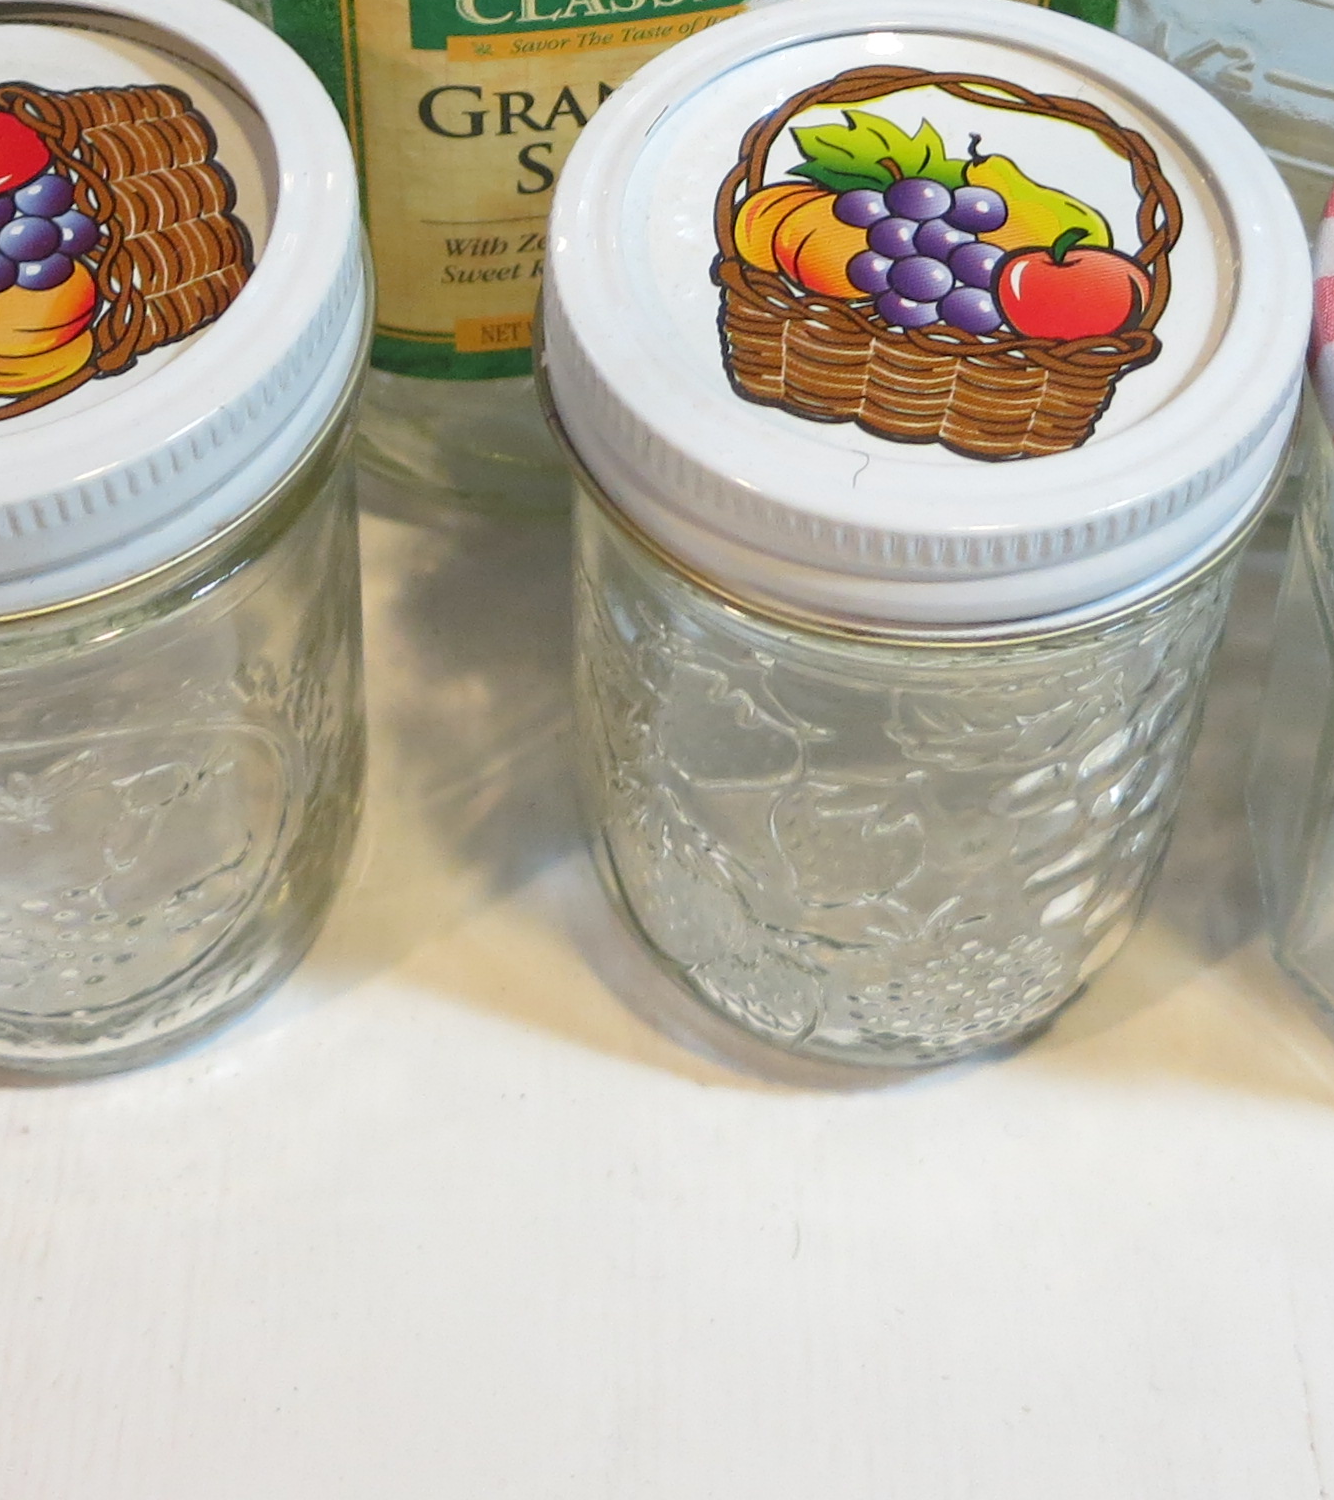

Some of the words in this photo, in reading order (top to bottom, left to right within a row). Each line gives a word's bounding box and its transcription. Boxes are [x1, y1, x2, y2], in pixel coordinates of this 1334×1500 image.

[510, 37, 572, 55] Savor
[577, 30, 615, 49] The
[620, 23, 673, 47] Taste
[418, 80, 622, 139] GRA
[444, 236, 509, 259] With
[441, 262, 522, 285] Sweet
